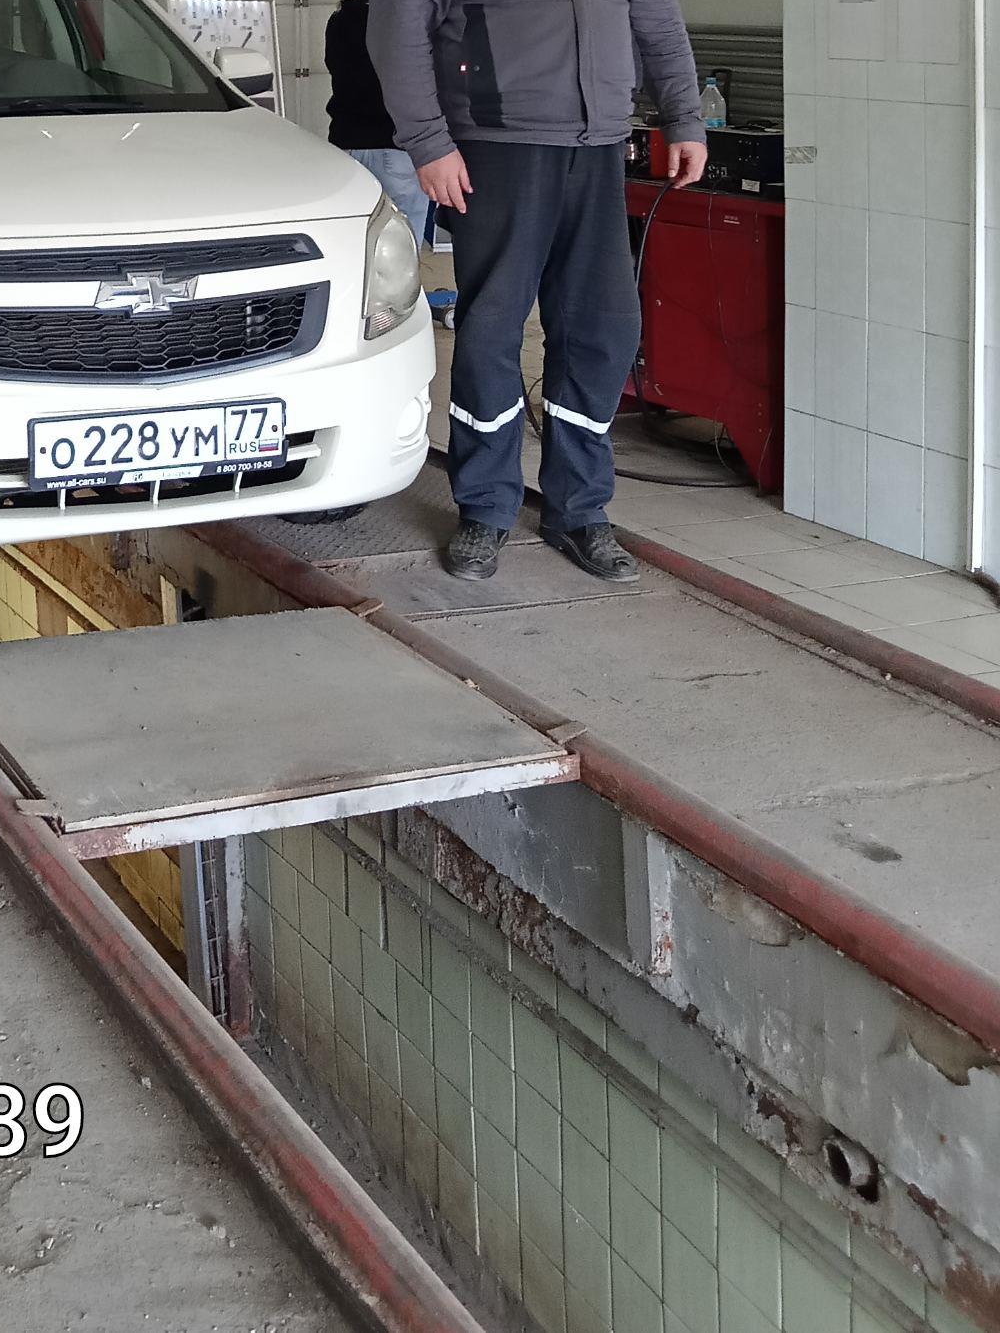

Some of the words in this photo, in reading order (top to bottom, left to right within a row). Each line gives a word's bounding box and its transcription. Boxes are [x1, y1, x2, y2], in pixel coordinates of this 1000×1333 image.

[230, 407, 269, 442] 77
[228, 441, 258, 455] RUS
[216, 465, 222, 473] 8
[223, 464, 237, 473] 800
[46, 476, 107, 489] www.all-cars.su
